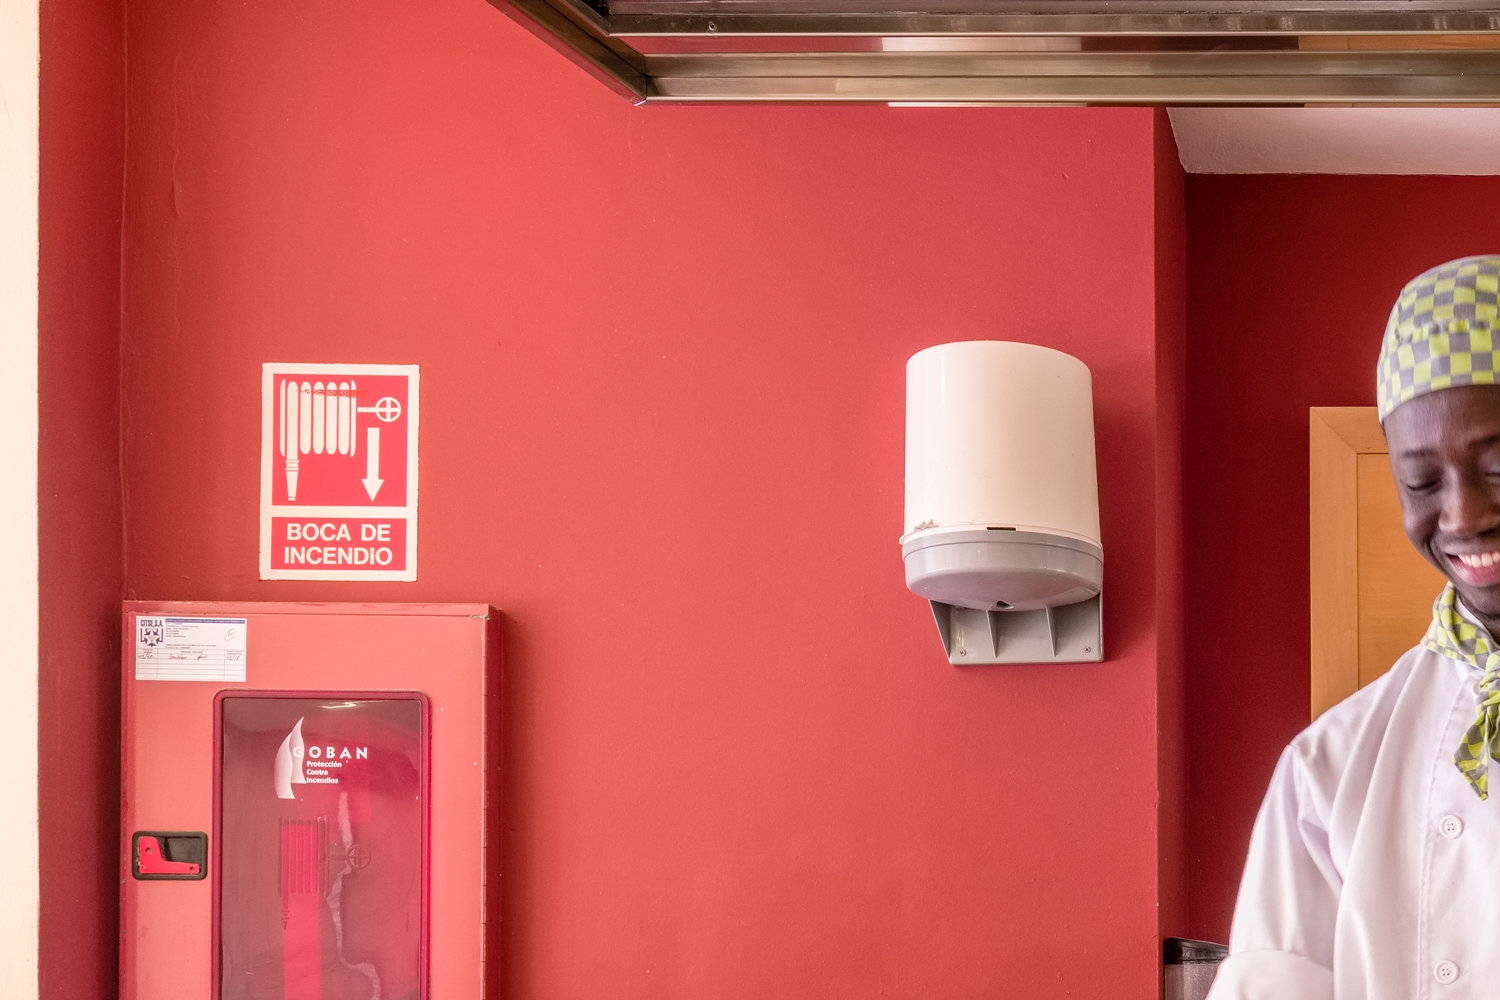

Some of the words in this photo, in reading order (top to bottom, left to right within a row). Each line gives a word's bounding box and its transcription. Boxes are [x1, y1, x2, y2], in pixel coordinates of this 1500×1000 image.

[286, 522, 351, 542] BOCA
[361, 523, 391, 542] DE
[284, 546, 393, 566] INCENDIO
[292, 745, 368, 760] GOBAN
[306, 760, 342, 768] Protección
